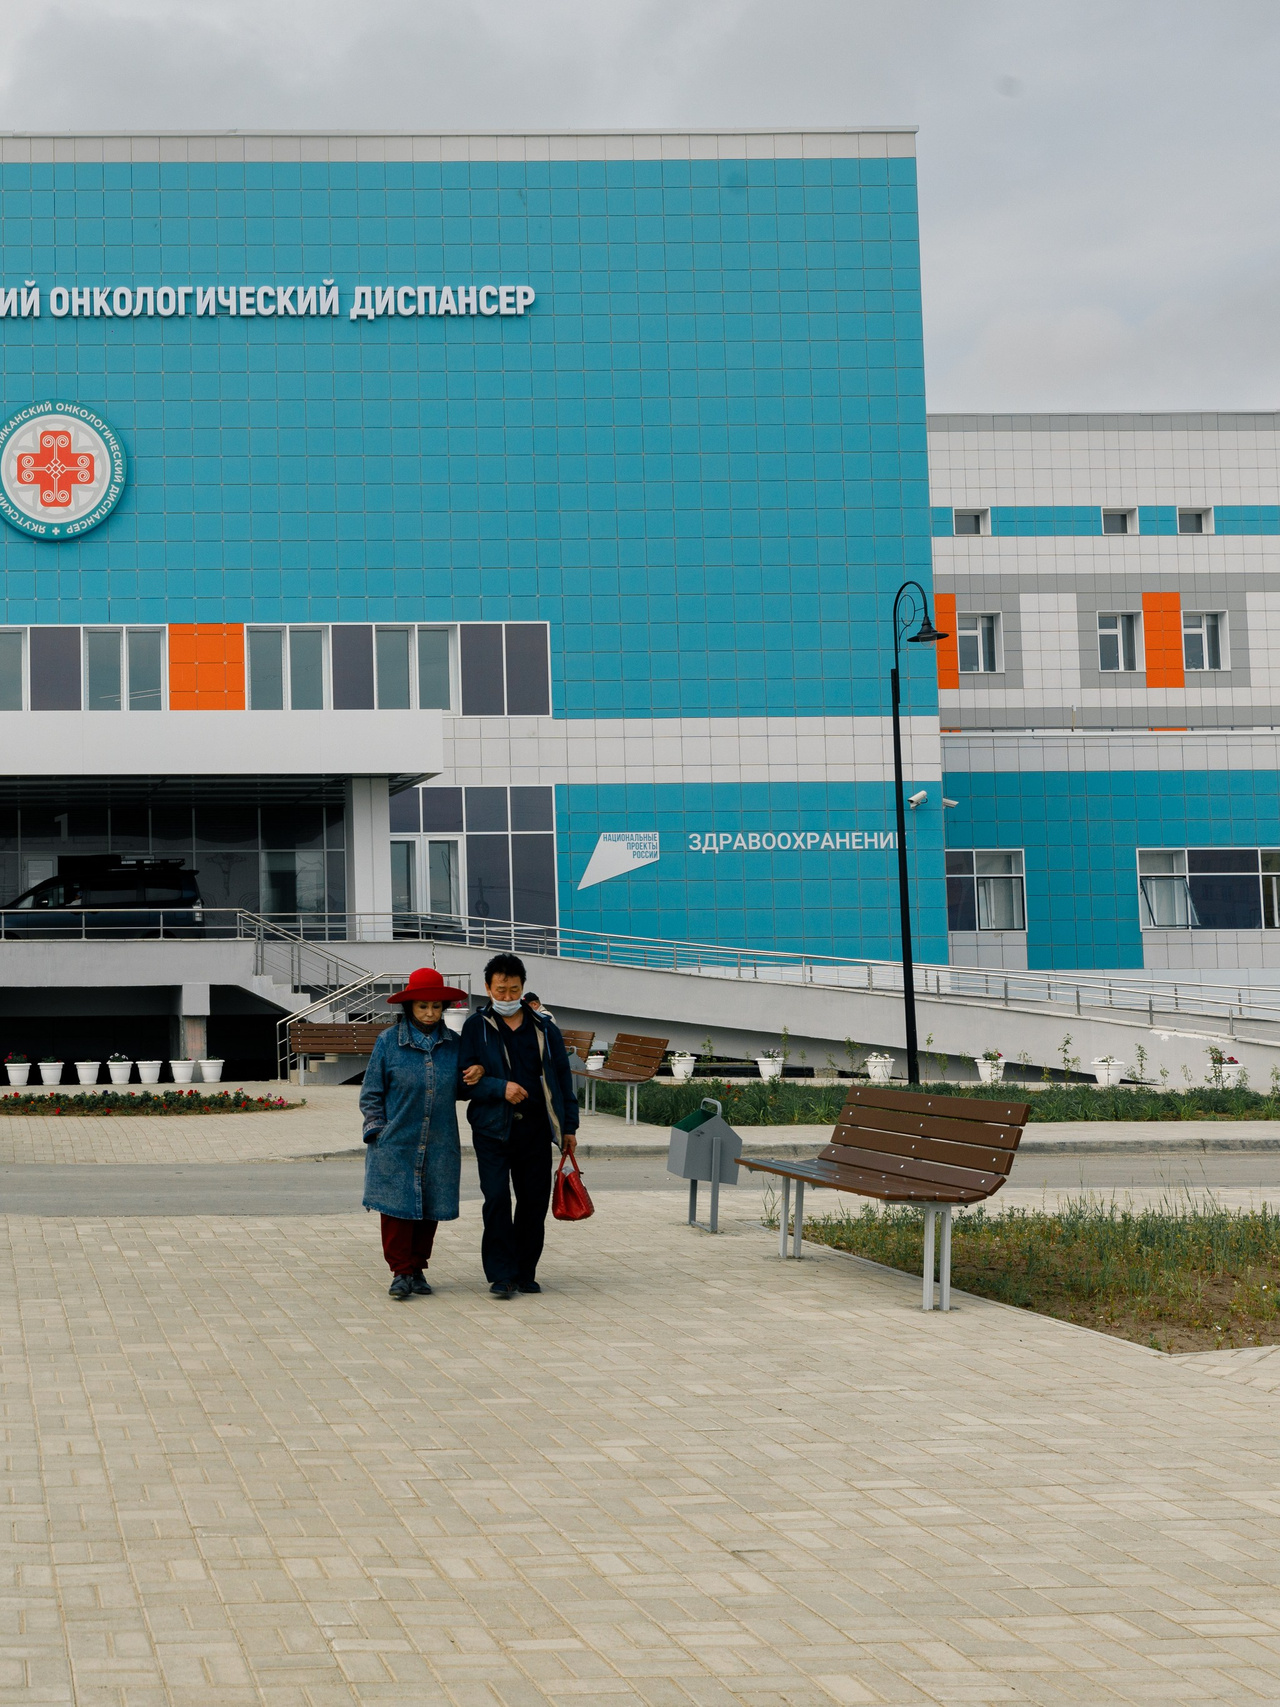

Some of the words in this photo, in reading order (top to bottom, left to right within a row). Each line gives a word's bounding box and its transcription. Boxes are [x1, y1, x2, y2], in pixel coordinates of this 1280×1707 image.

[49, 279, 339, 318] ОНКОЛОГИЧЕСКИЙ
[349, 285, 536, 321] ДИСПАНСЕР
[55, 402, 124, 483] ОНКОЛОГИЧЕСКИЙ
[66, 484, 120, 534] ДИСПАНСЕР
[54, 812, 69, 842] 1
[602, 833, 658, 842] НАЦИОНАЛЬНЫЕ
[626, 842, 658, 851] ПРОЕКТЫ
[632, 850, 658, 859] РОССИИ
[688, 832, 908, 854] ЗДРАВООХРАНЕНИ
